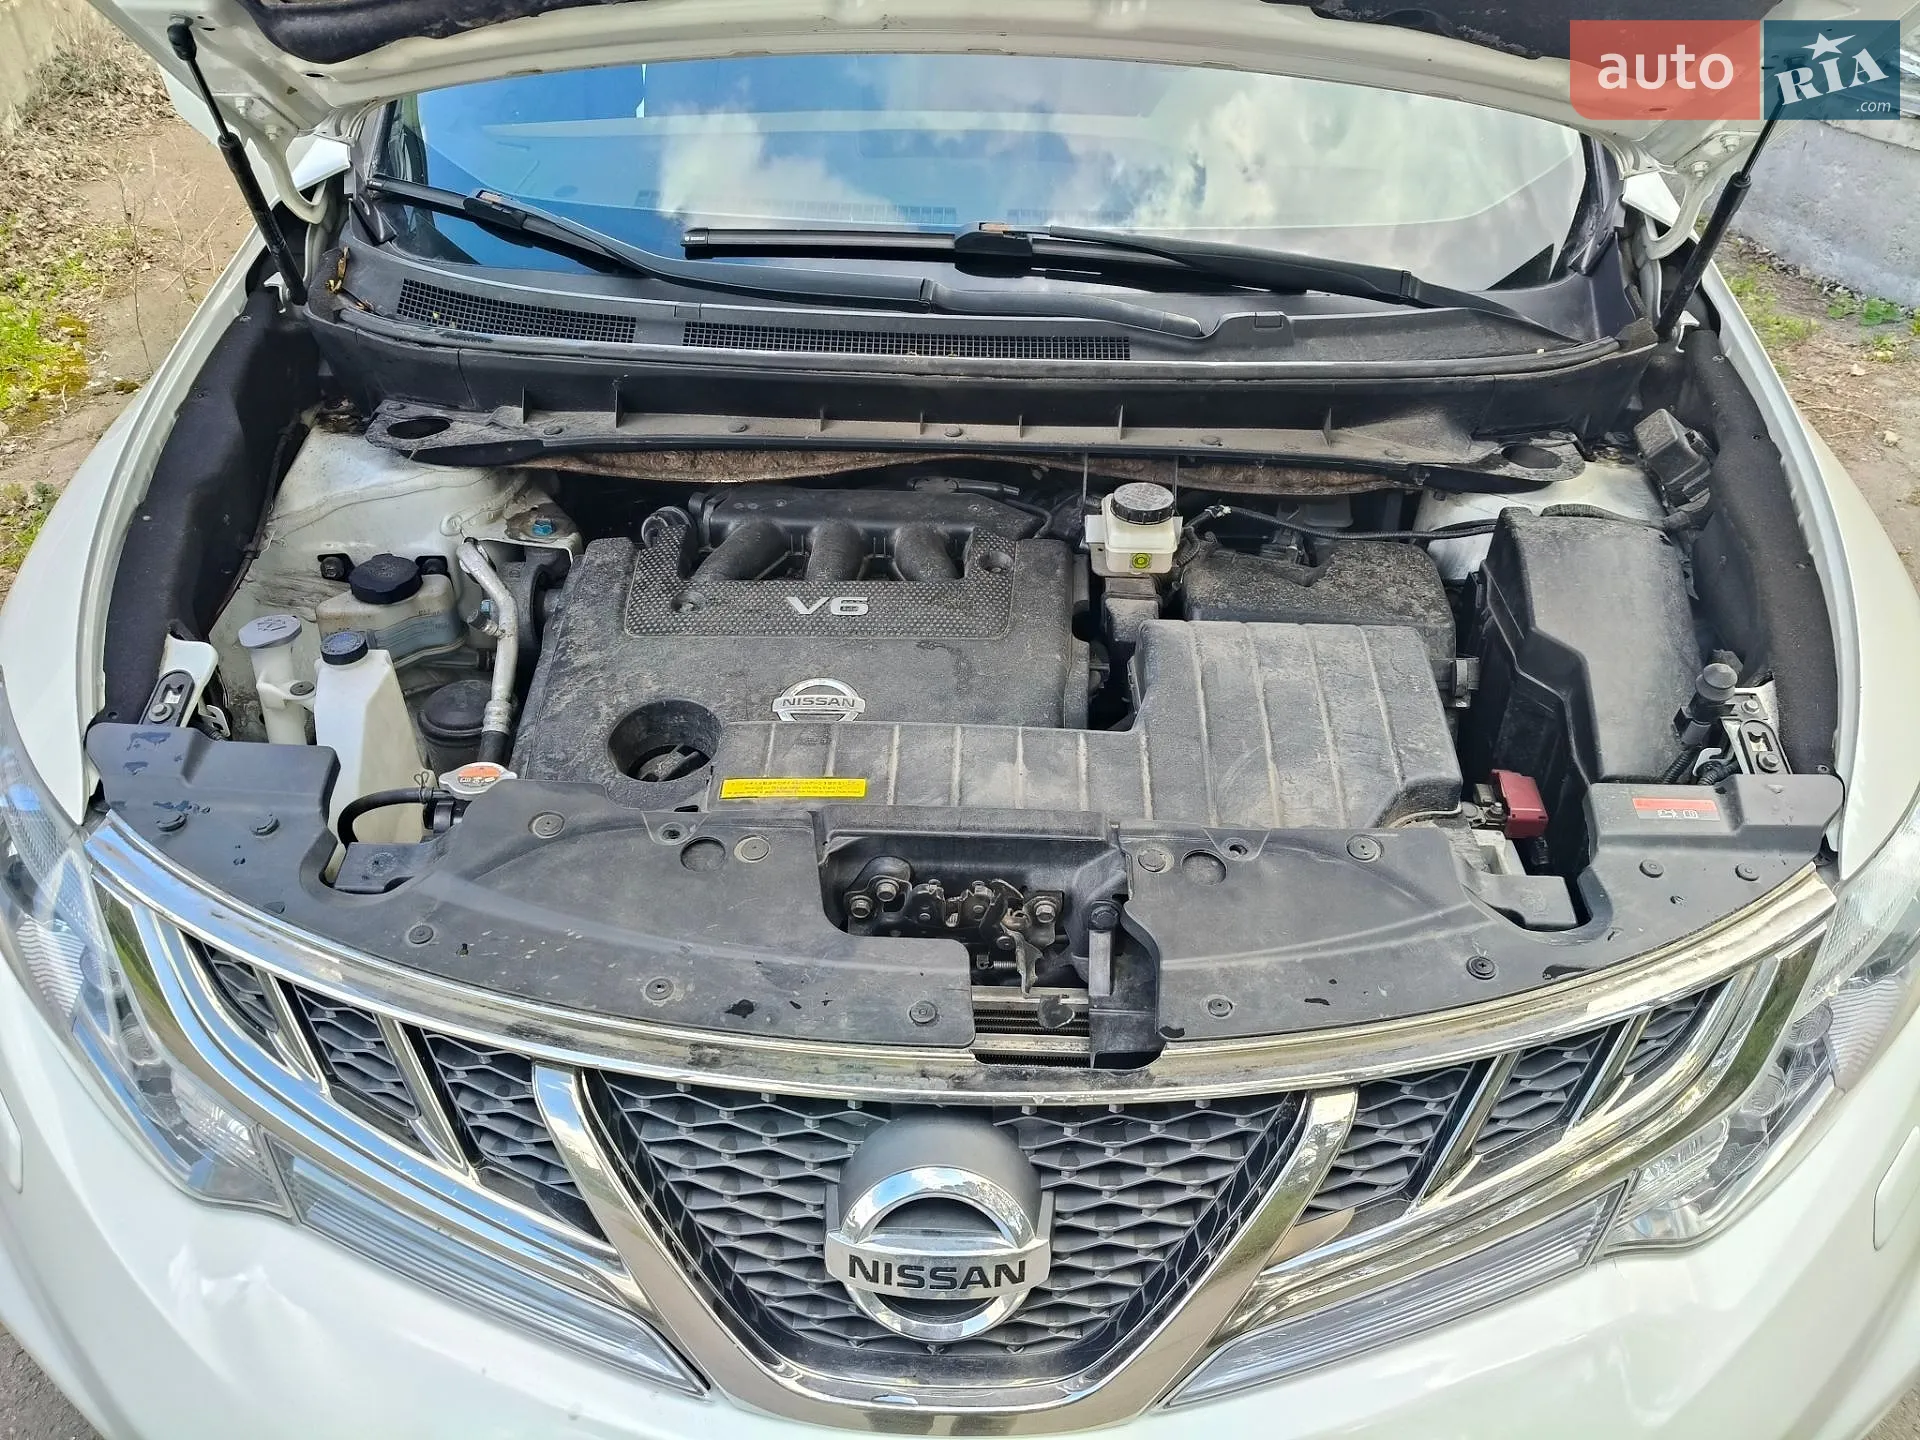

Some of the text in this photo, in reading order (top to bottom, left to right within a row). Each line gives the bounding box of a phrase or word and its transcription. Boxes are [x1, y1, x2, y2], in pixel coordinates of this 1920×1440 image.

[785, 596, 869, 616] V6
[782, 696, 855, 708] NISSAN
[848, 1254, 1026, 1290] NISSAN
